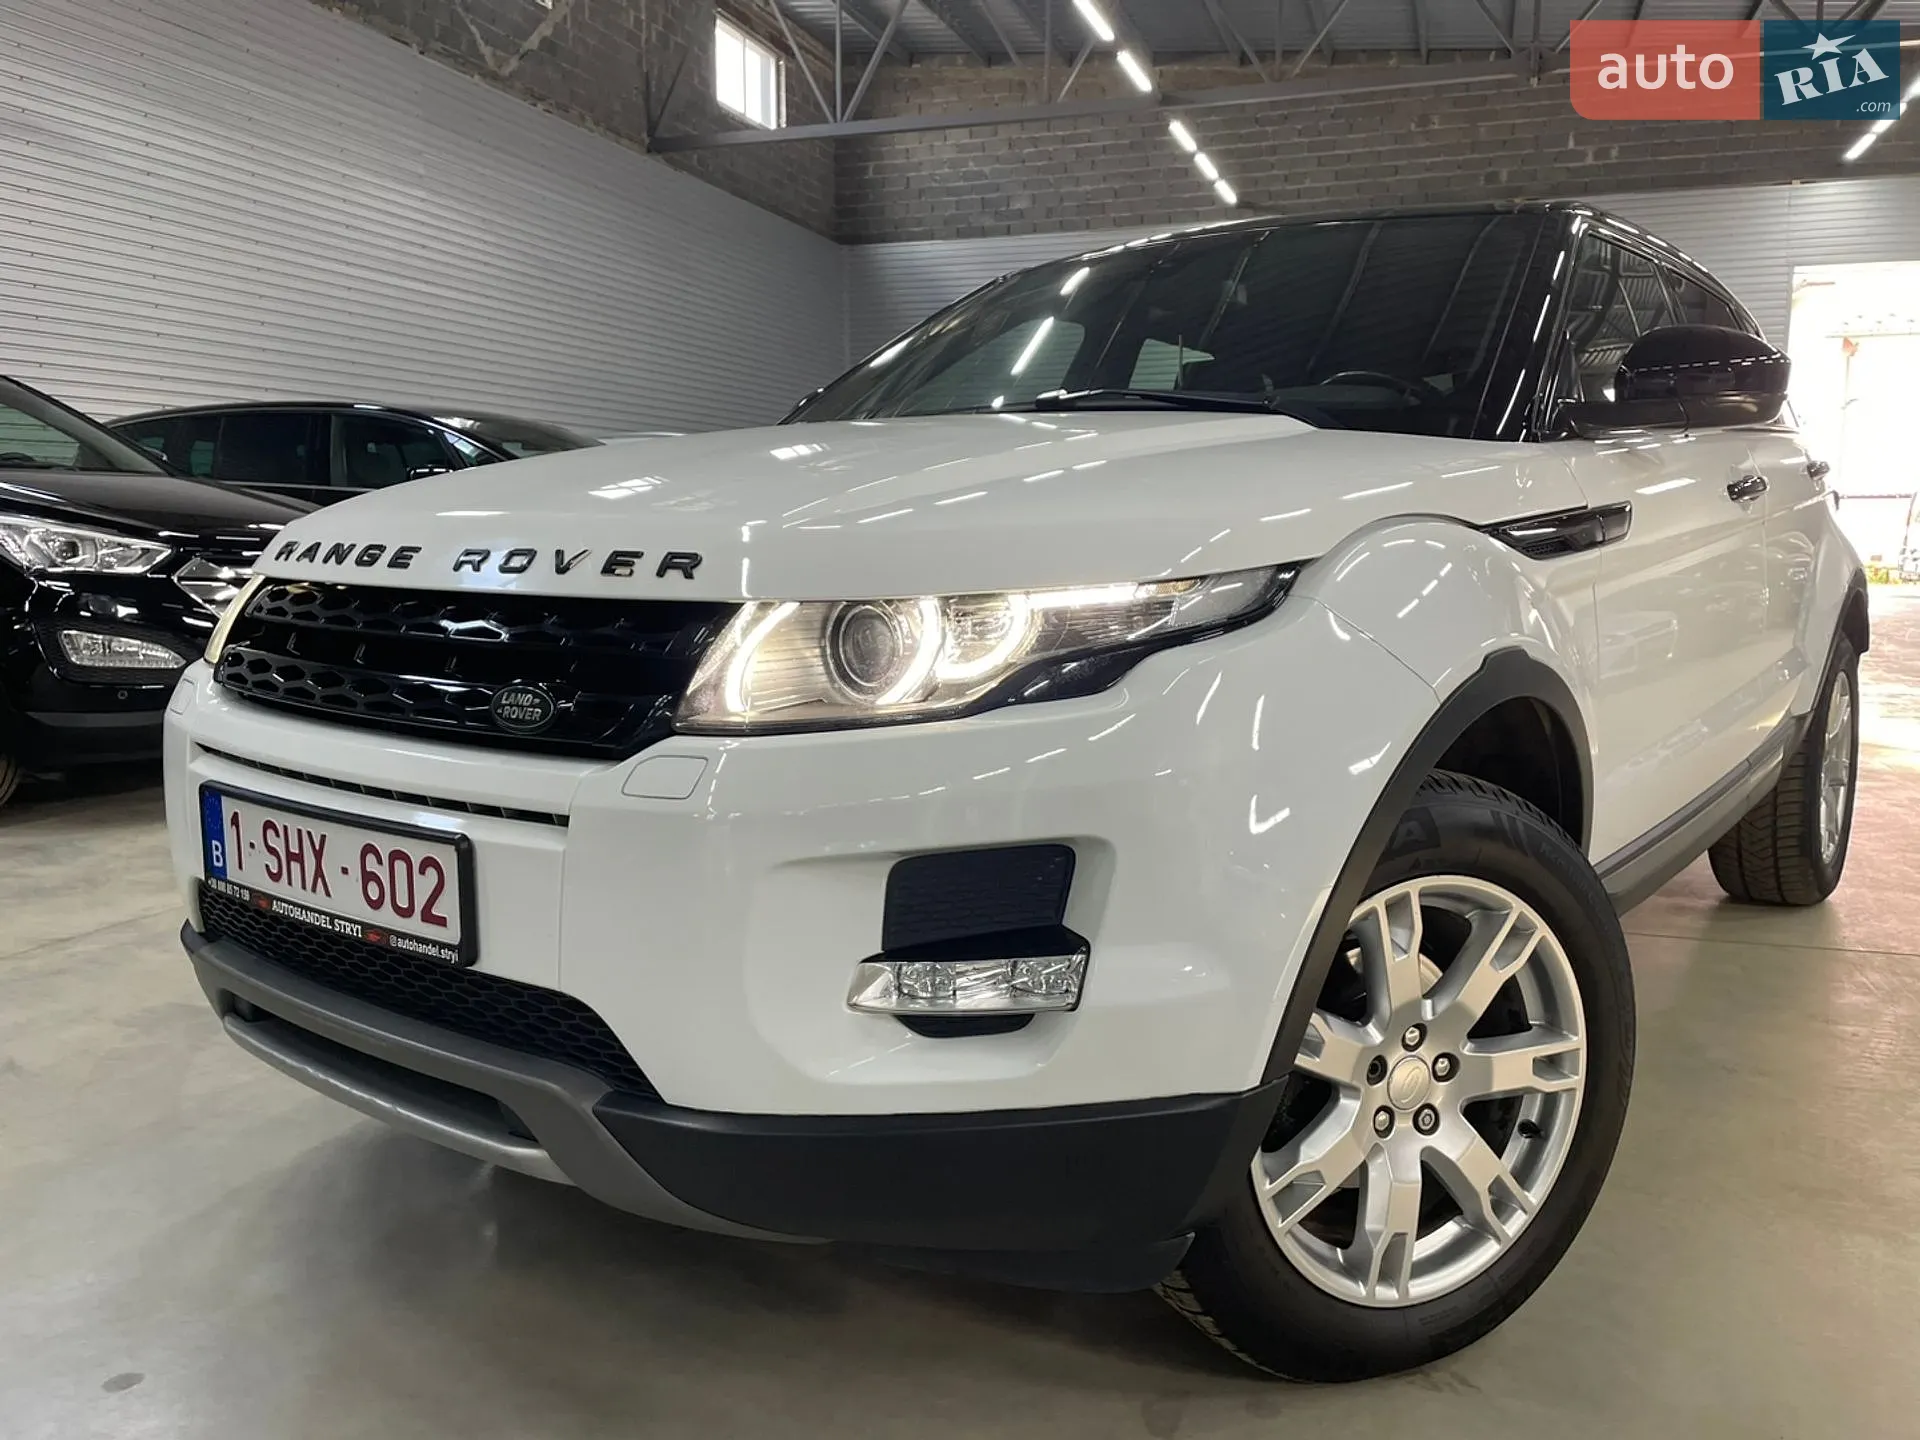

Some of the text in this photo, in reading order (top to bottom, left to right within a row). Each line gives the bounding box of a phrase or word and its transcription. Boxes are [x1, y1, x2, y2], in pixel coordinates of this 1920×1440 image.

[274, 541, 703, 580] RANGE ROVER
[212, 839, 224, 868] B
[272, 900, 362, 938] AUTOHANDEL STRYI
